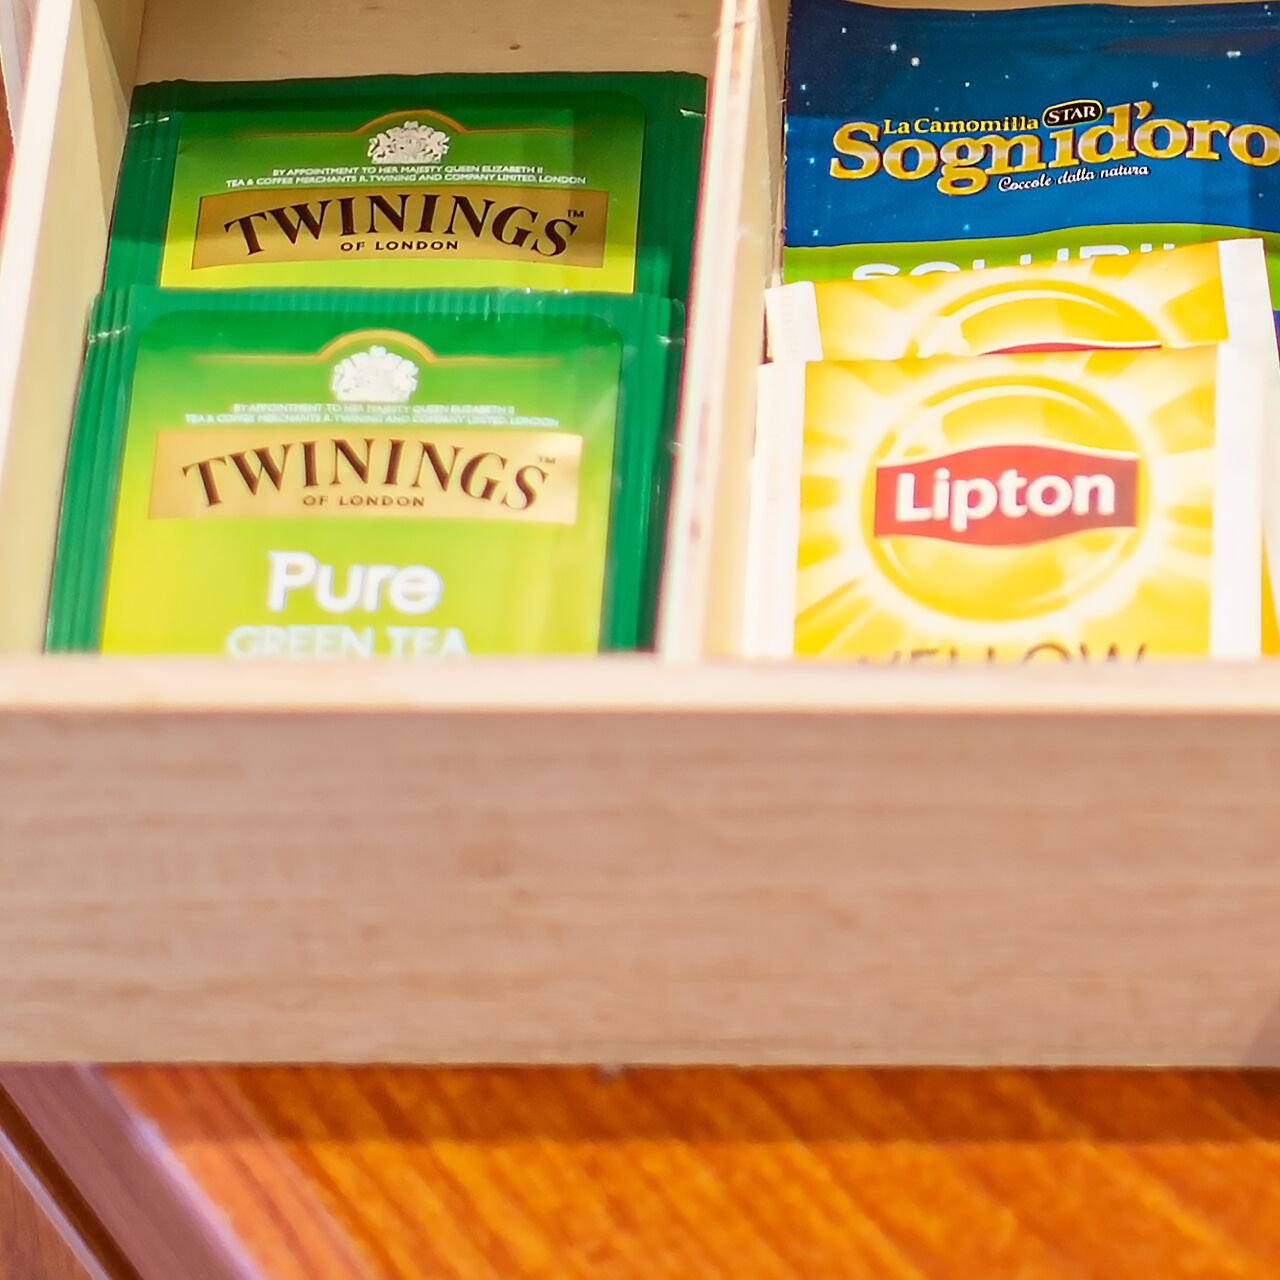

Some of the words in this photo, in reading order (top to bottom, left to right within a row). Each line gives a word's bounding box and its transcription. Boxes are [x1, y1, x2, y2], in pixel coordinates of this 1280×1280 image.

[1047, 106, 1096, 124] STAR
[884, 119, 910, 134] La
[914, 116, 1039, 132] Camomilla
[273, 168, 285, 176] BY
[362, 166, 375, 175] TO
[378, 166, 399, 175] HER
[998, 173, 1053, 192] Coccole
[1057, 166, 1096, 185] dalla
[1101, 164, 1149, 178] natura
[226, 179, 245, 188] TEA
[418, 173, 442, 182] AND
[538, 175, 586, 184] LONDON
[224, 193, 578, 257] TWININGS
[340, 241, 365, 251] OF
[375, 240, 458, 251] LONDON
[182, 438, 549, 511] TWININGS
[303, 495, 327, 507] OF
[339, 495, 425, 507] LONDON
[895, 468, 1117, 532] Lipton
[266, 549, 444, 614] Pure
